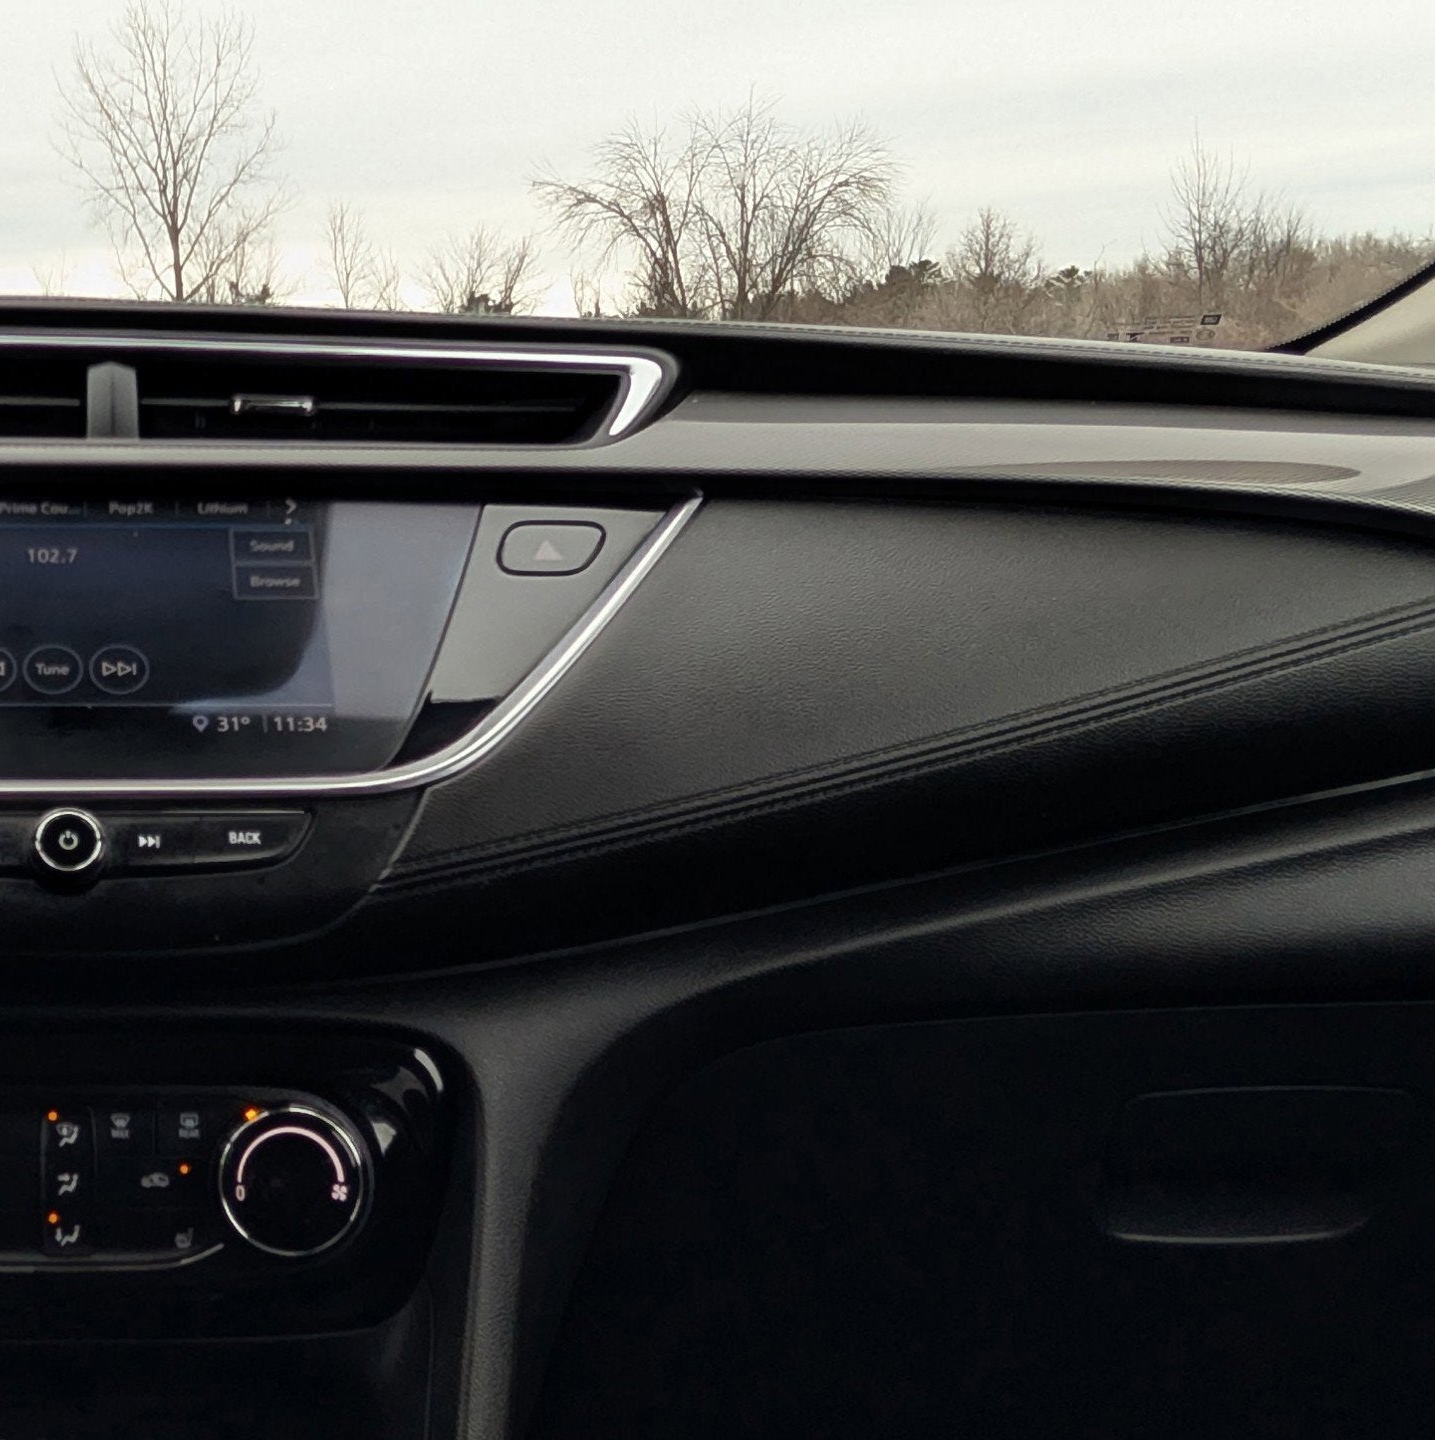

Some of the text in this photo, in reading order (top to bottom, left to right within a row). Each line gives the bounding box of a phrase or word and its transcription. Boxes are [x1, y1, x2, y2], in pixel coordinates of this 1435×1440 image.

[109, 502, 153, 517] Pop2K
[197, 502, 248, 515] Lithium
[250, 539, 294, 552] Sound
[27, 547, 79, 564] 102.7
[250, 575, 301, 588] Browse
[35, 662, 70, 676] Tune
[217, 716, 328, 733] 31° 11:34
[229, 831, 261, 845] BACK
